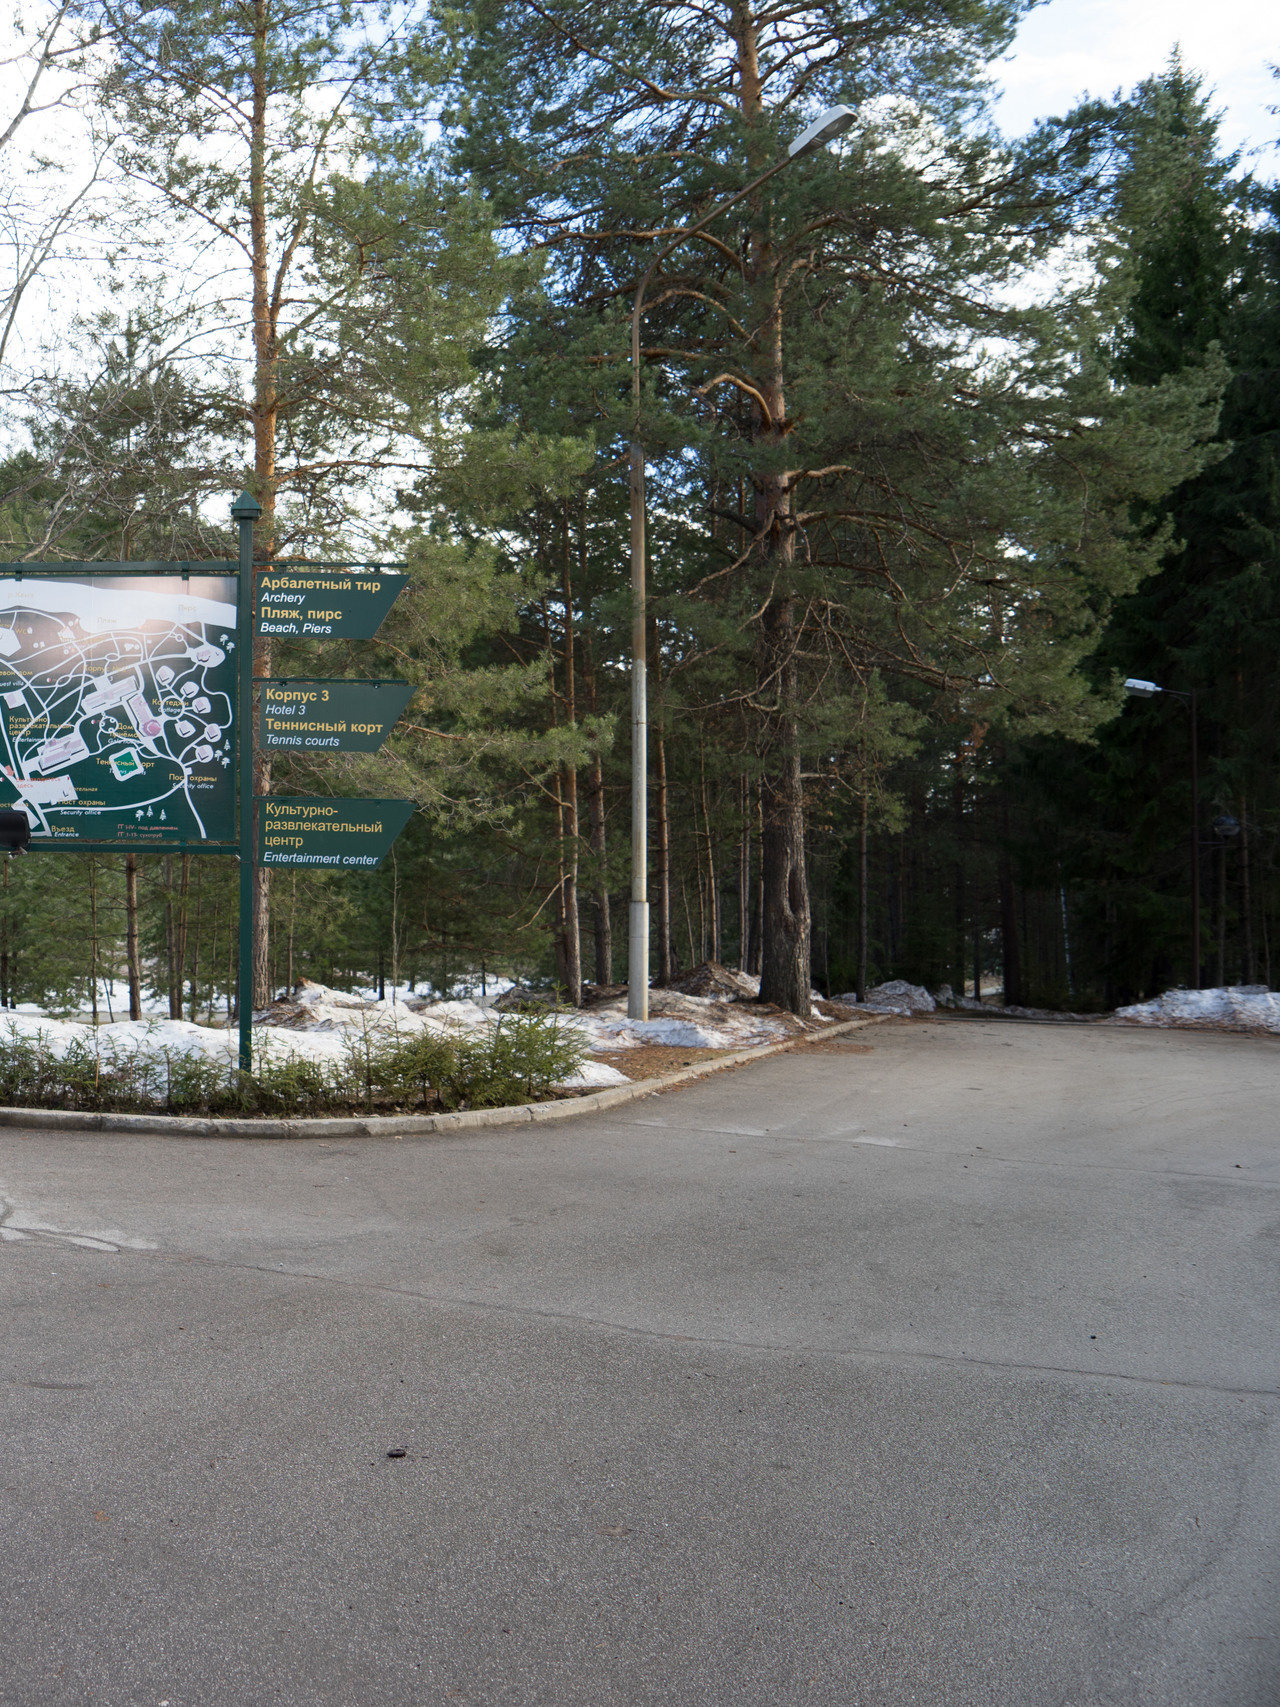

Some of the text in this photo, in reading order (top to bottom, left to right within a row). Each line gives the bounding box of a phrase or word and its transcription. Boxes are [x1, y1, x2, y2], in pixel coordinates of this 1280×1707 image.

[260, 576, 381, 594] Арбалетный тир
[260, 592, 306, 606] Archery
[261, 606, 343, 622] Пляж, пирс
[260, 622, 332, 635] Beach, Piers
[152, 698, 189, 707] Котеджи
[266, 688, 330, 704] Корпус 3
[265, 704, 306, 716] Hotel 3
[265, 717, 384, 736] Теннисный корт
[266, 733, 340, 747] Tennis courts
[189, 776, 218, 784] охраны
[77, 799, 107, 807] охраны
[266, 802, 339, 819] Культурно-
[51, 824, 76, 833] Въезд
[265, 818, 383, 834] развлекательный
[264, 836, 304, 850] центр
[263, 851, 379, 866] Entertainment center
